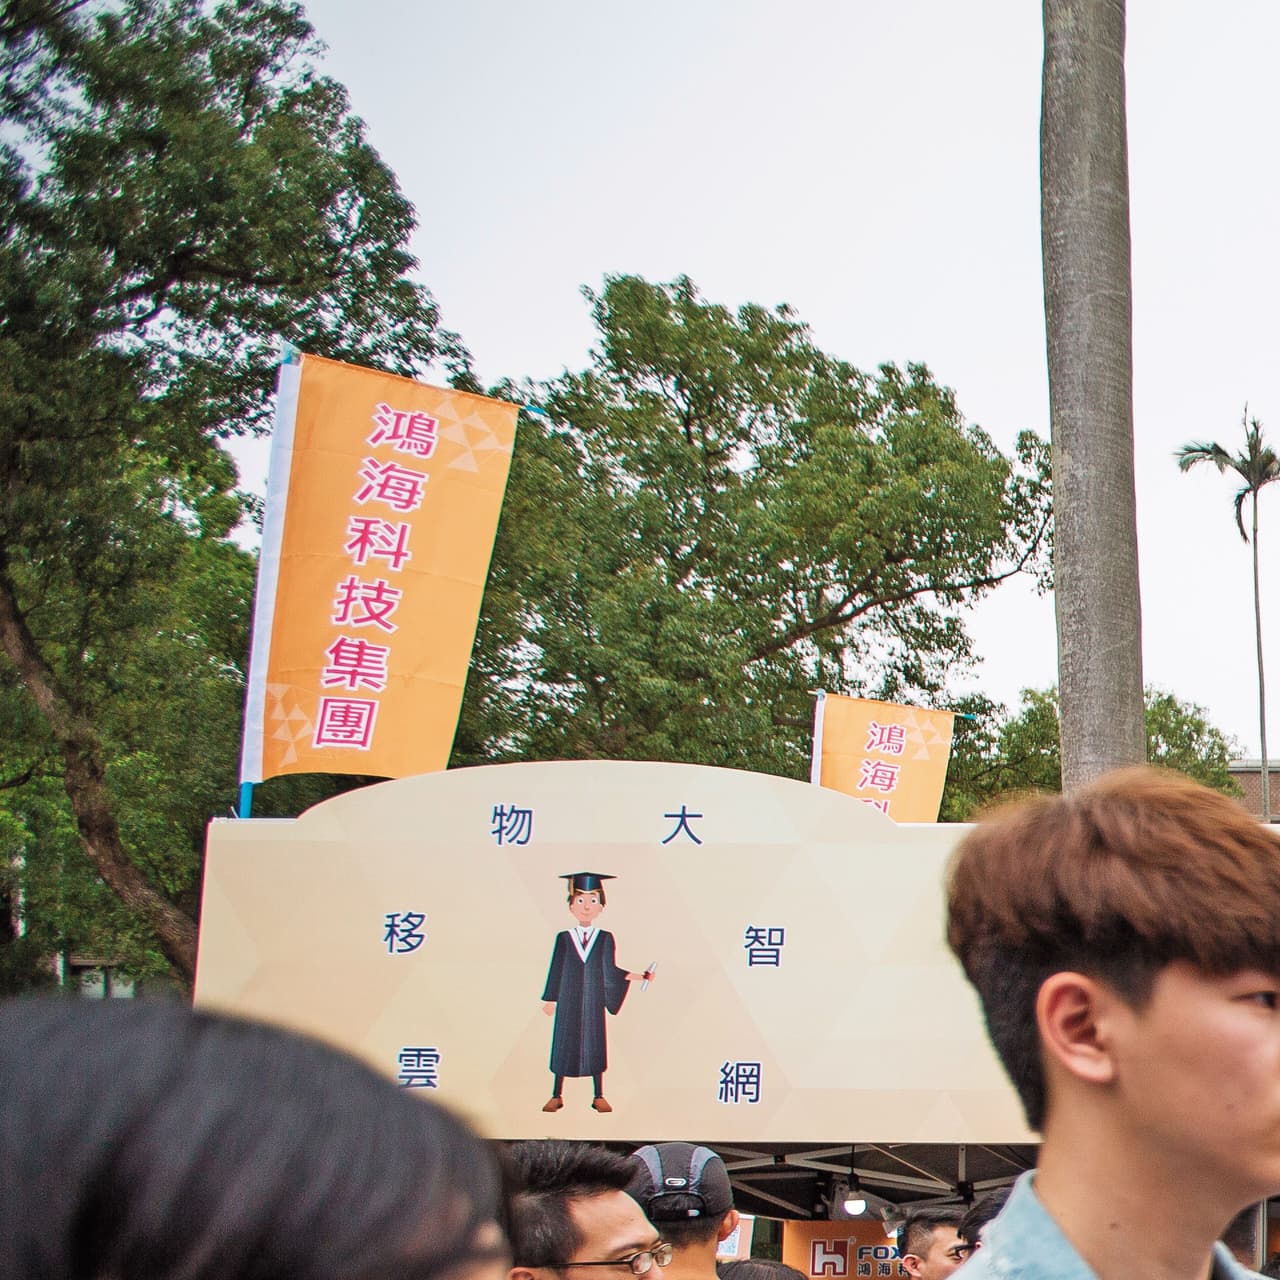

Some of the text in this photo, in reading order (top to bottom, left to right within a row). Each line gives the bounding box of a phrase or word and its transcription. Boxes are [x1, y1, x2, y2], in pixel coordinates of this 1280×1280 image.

[313, 402, 439, 750] 鴻海科技集團
[491, 804, 533, 845] 物
[662, 804, 704, 845] 大
[383, 911, 427, 954] 移
[744, 926, 785, 967] 智
[398, 1046, 441, 1089] 雲
[718, 1061, 762, 1103] 網
[858, 1246, 902, 1260] FOX
